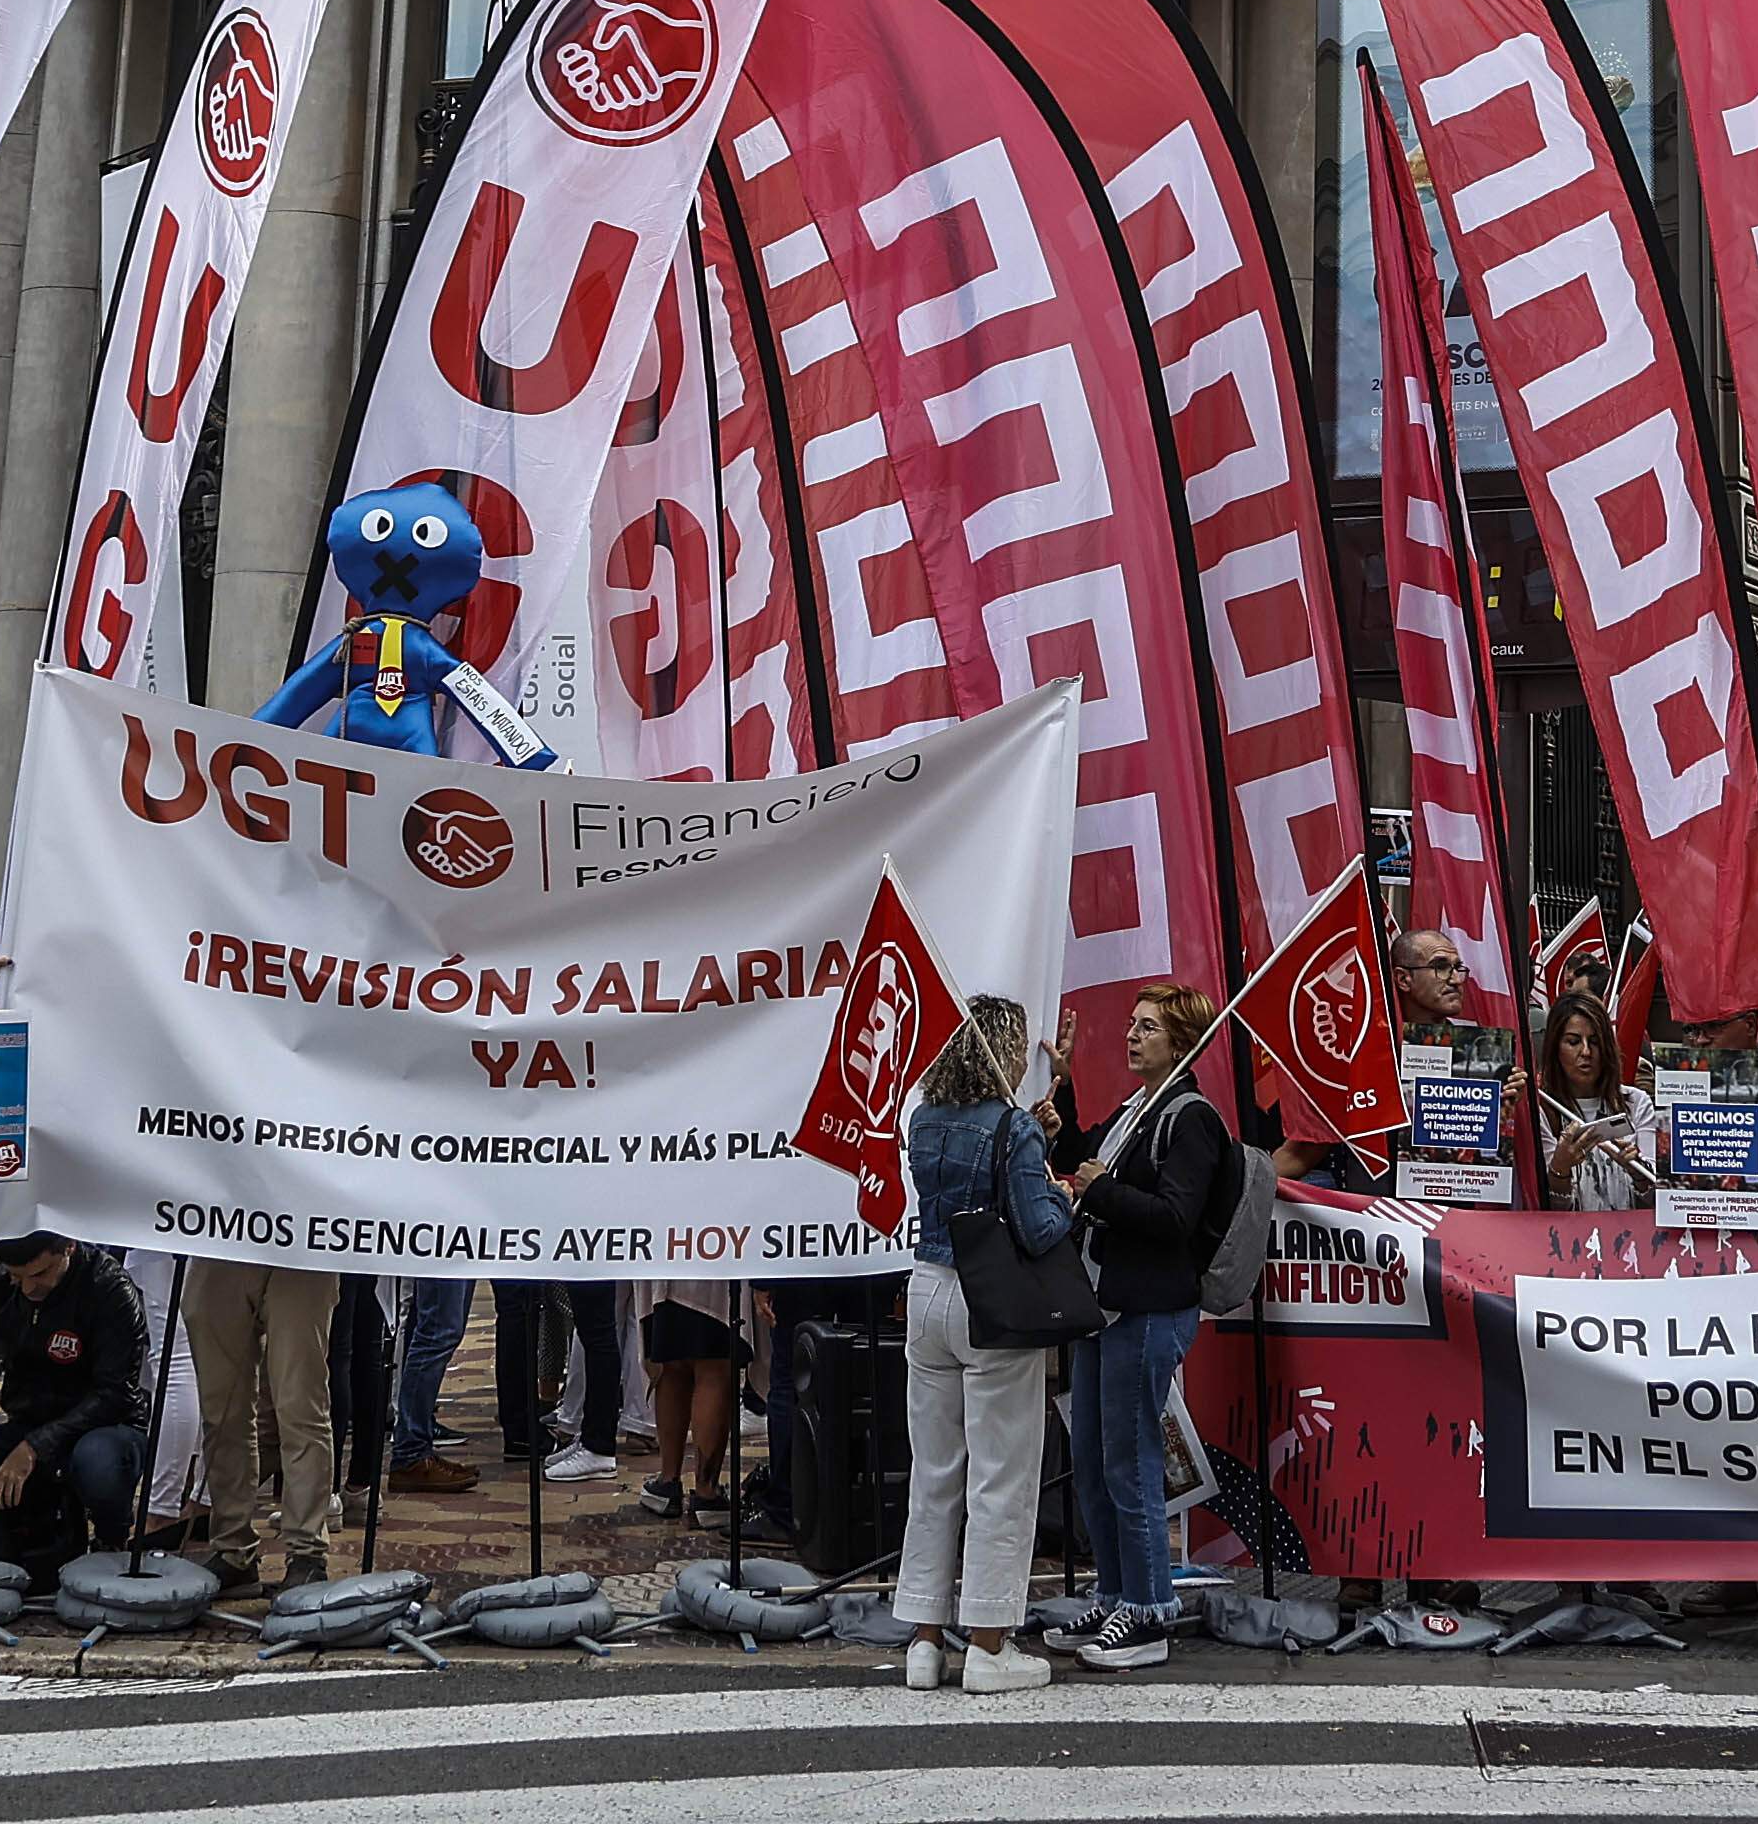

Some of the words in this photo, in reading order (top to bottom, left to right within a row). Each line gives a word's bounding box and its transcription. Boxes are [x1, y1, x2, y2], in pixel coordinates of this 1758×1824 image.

[377, 672, 404, 689] UGT
[552, 635, 576, 718] Social
[122, 713, 375, 868] UGT
[574, 753, 923, 852] Financiero
[184, 929, 533, 1017] ¡REVISIÓN
[470, 1039, 597, 1090] YA!
[1420, 1084, 1492, 1100] EXIGIMOS
[1421, 1102, 1450, 1111] pactar
[1452, 1102, 1490, 1113] medidas
[1423, 1113, 1444, 1121] para
[1446, 1113, 1487, 1122] solventar
[1677, 1111, 1755, 1125] EXIGIMOS
[137, 1106, 246, 1144] MENOS
[254, 1118, 402, 1159] PRESIÓN
[408, 1136, 610, 1165] COMERCIAL
[620, 1136, 642, 1164] Y
[650, 1131, 717, 1164] MÁS
[1423, 1122, 1432, 1130] el
[1434, 1122, 1470, 1134] impacto
[1472, 1124, 1484, 1132] de
[1680, 1129, 1711, 1138] pactar
[1713, 1128, 1753, 1138] medidas
[1430, 1132, 1439, 1140] la
[1440, 1131, 1479, 1142] inflación
[1682, 1139, 1704, 1148] para
[1706, 1139, 1751, 1148] solventar
[1683, 1148, 1692, 1156] el
[1694, 1148, 1733, 1161] impacto
[1735, 1150, 1748, 1158] de
[1691, 1159, 1700, 1167] la
[1701, 1159, 1743, 1168] inflación
[153, 1198, 294, 1250] SOMOS
[306, 1215, 542, 1263] ESENCIALES
[552, 1228, 654, 1263] AYER
[665, 1226, 750, 1262] HOY
[1536, 1308, 1648, 1357] POR
[1667, 1314, 1737, 1357] LA
[50, 1333, 78, 1351] UGT
[1553, 1428, 1626, 1475] EN
[1642, 1439, 1708, 1477] EL
